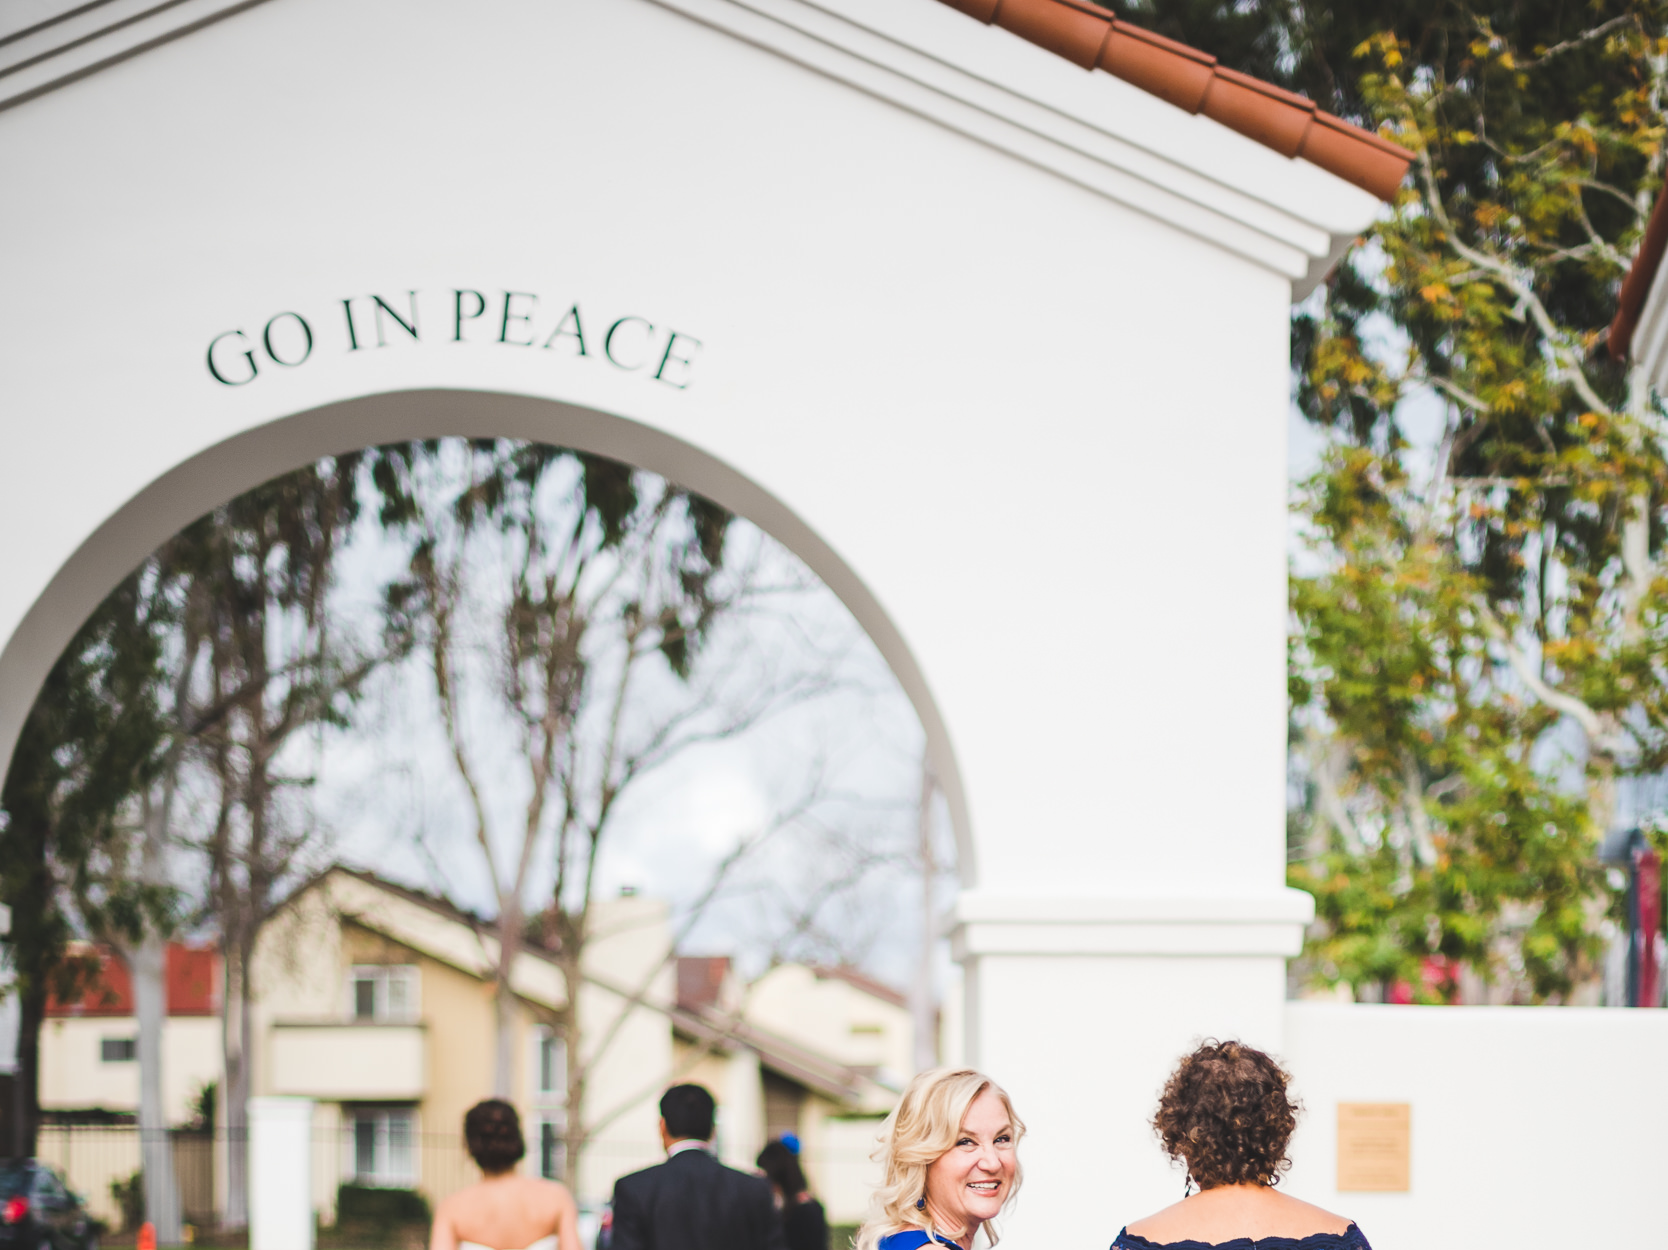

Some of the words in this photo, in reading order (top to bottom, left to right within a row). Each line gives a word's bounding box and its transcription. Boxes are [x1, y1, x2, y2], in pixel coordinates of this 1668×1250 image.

[205, 309, 316, 388] GO
[342, 289, 421, 354] IN
[453, 288, 702, 390] PEACE
